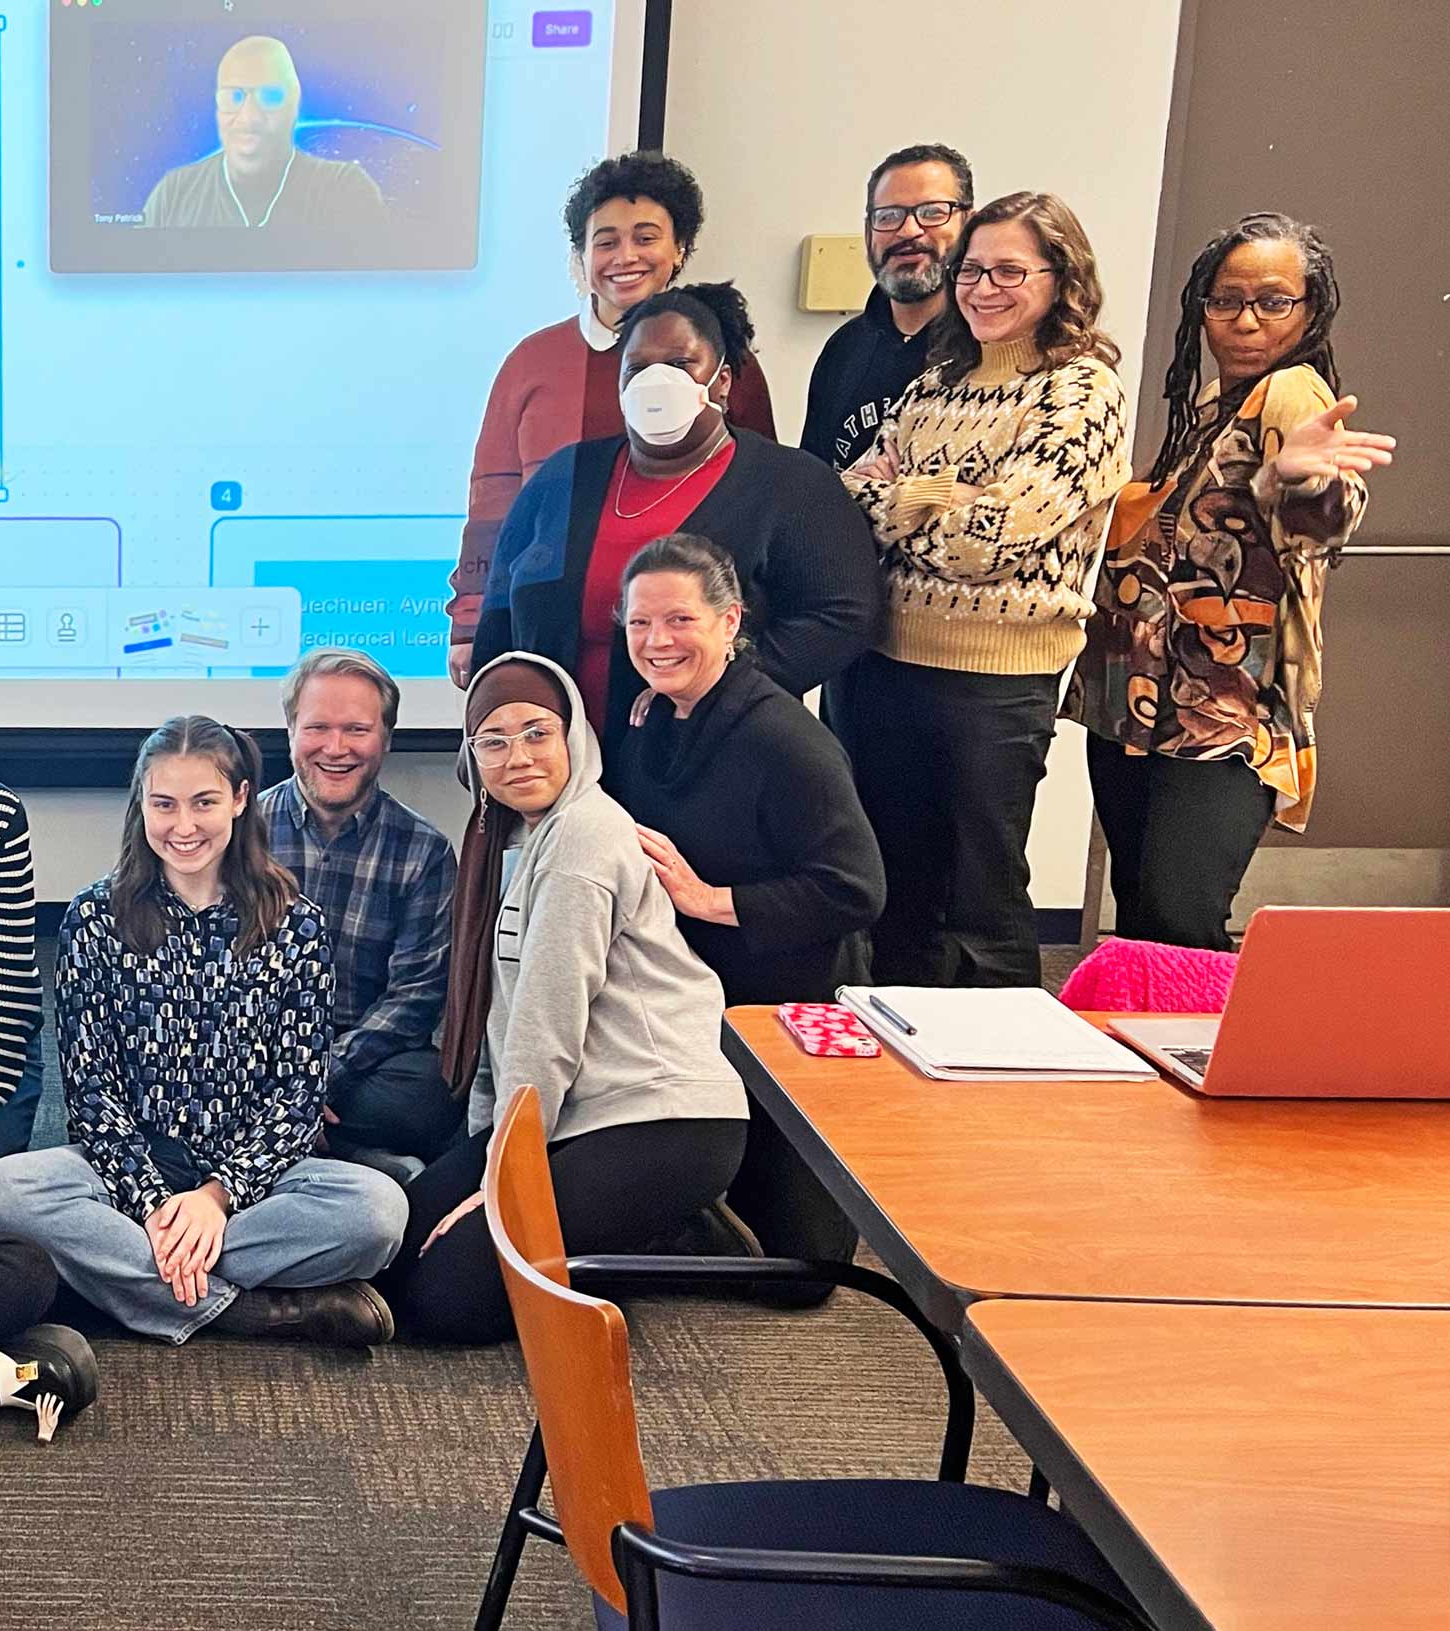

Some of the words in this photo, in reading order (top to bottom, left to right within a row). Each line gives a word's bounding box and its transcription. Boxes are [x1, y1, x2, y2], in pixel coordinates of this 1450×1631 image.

[545, 23, 579, 36] Share
[221, 487, 232, 502] 4
[302, 629, 396, 647] eciprocal
